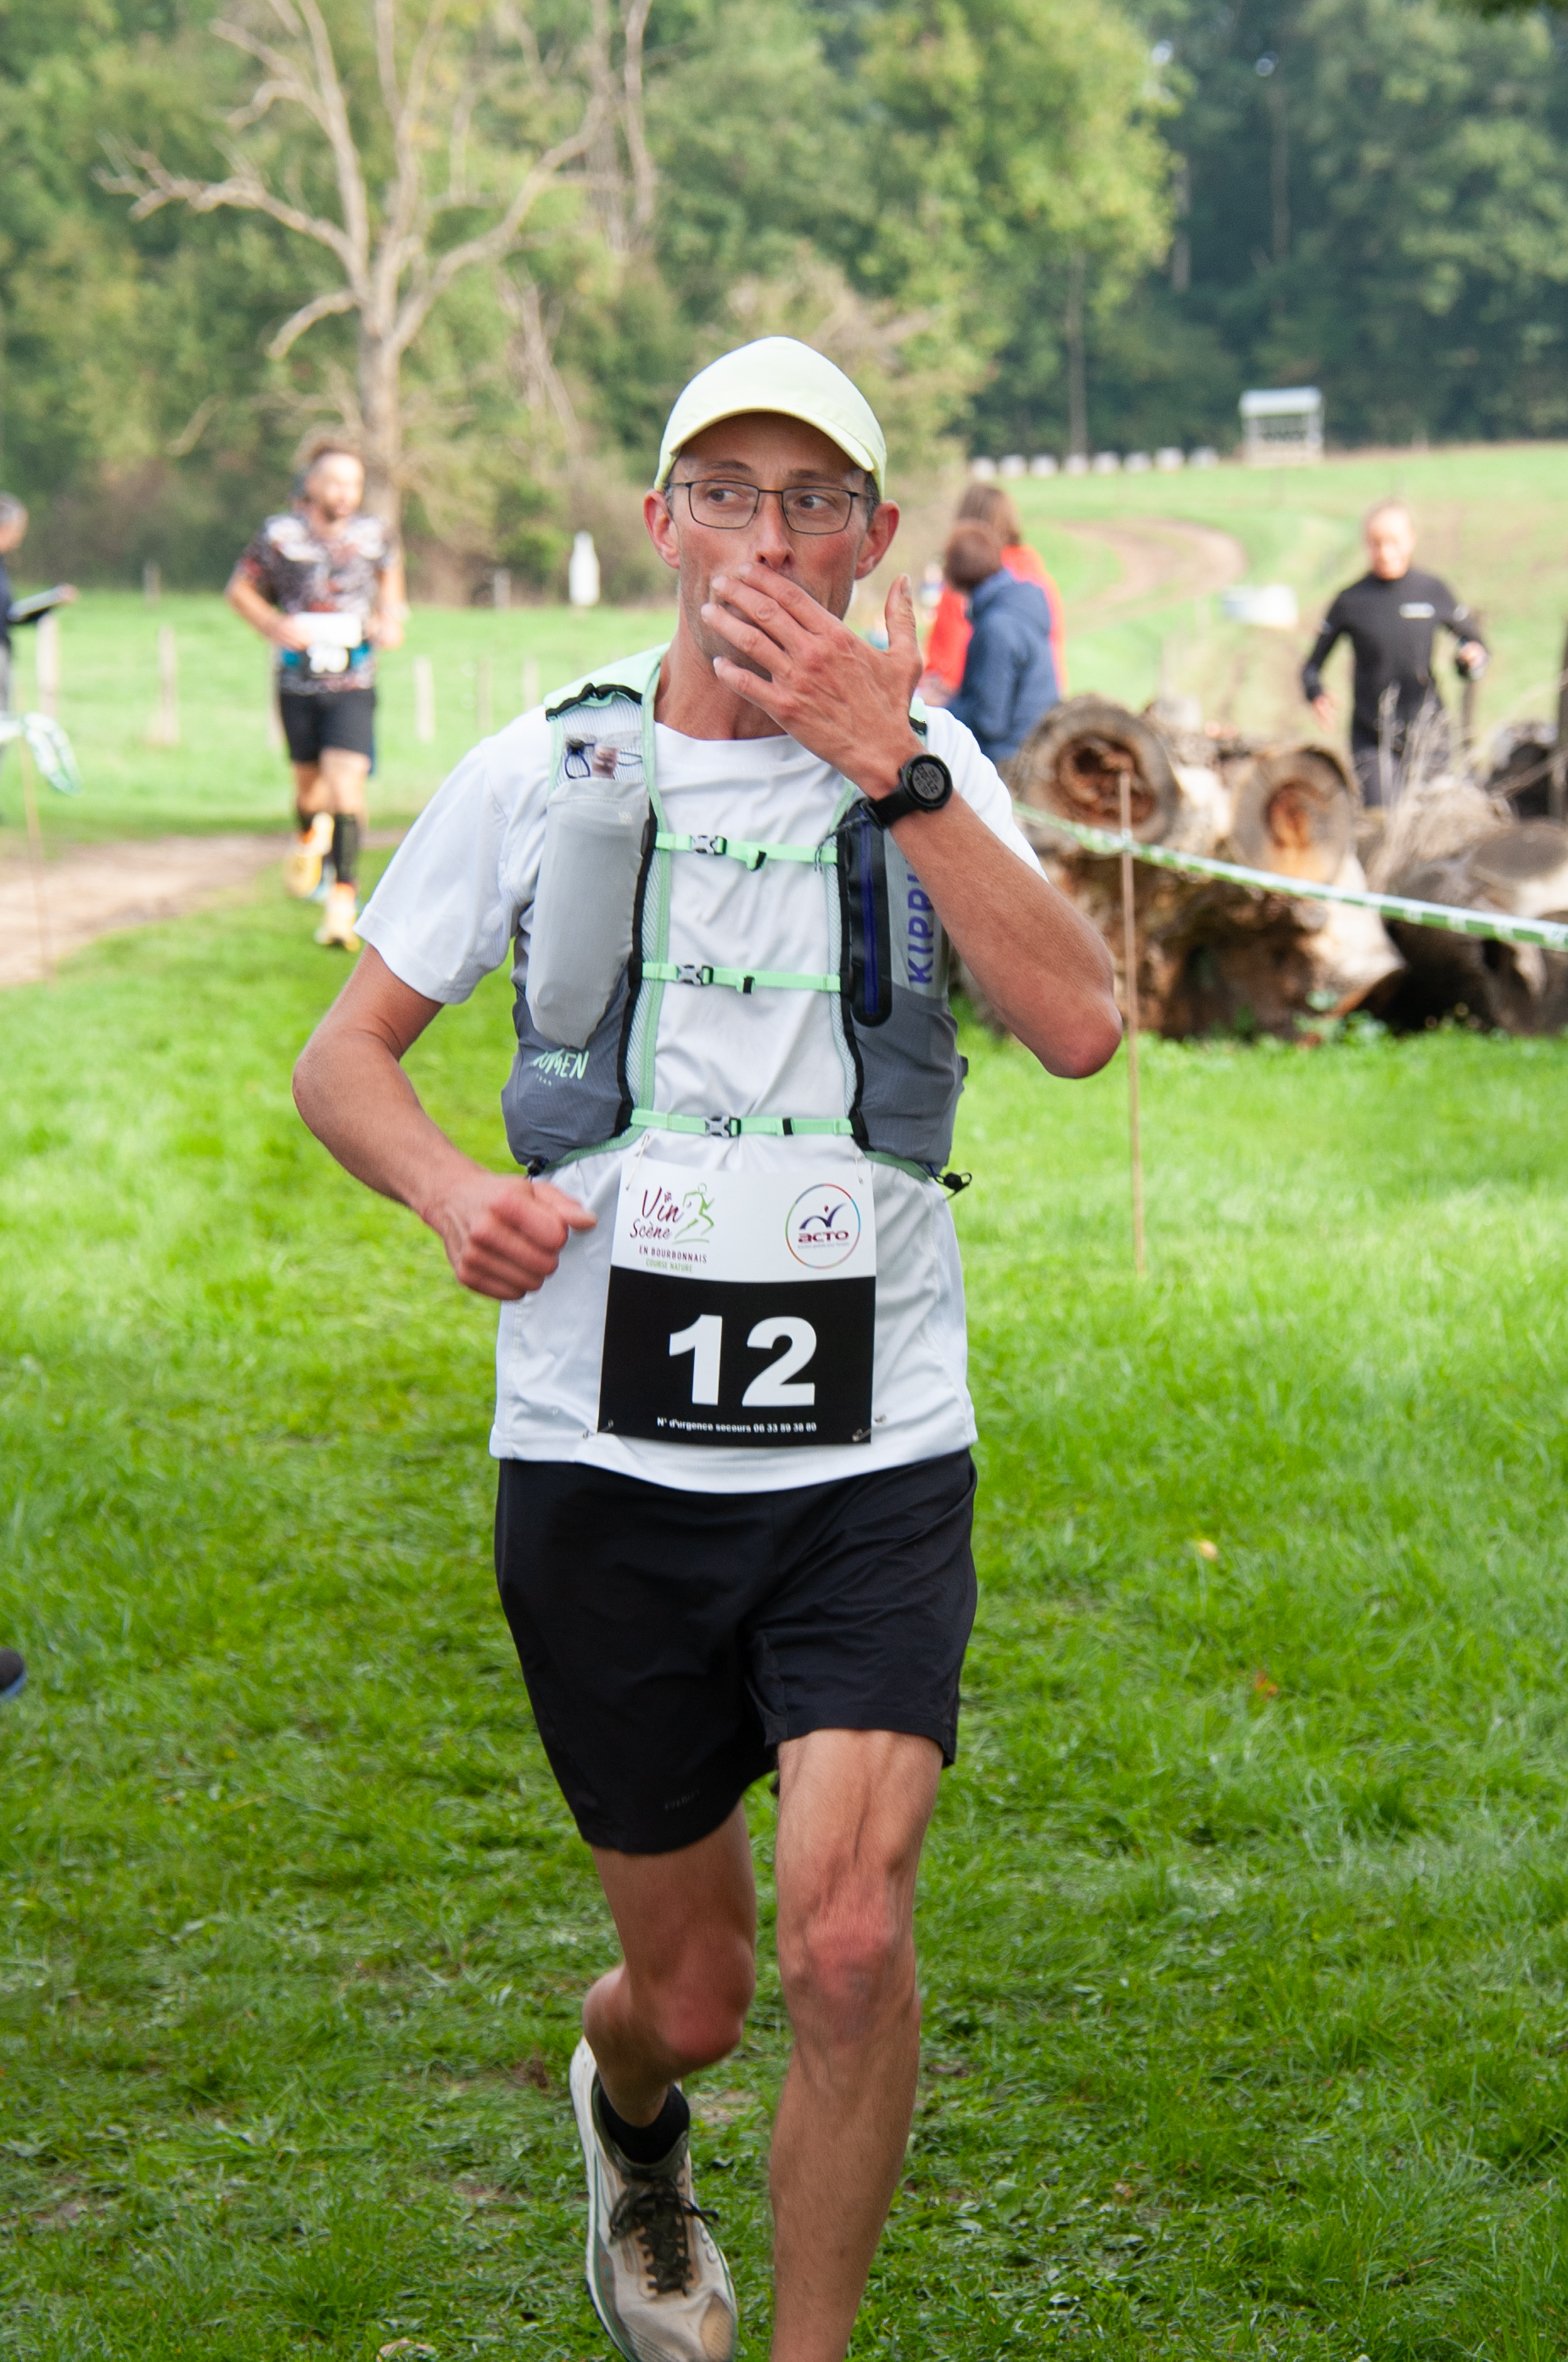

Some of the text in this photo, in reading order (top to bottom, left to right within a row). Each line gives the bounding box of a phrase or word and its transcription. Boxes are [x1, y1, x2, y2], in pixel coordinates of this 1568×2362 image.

[907, 872, 934, 985] KIPR
[642, 1185, 684, 1223] Vin
[630, 1218, 671, 1239] Scène
[639, 1244, 707, 1263] EN BOURBONNAIS
[669, 1261, 692, 1272] NATURE
[667, 1314, 818, 1408] 12
[669, 1419, 714, 1431] d'urgence
[715, 1423, 752, 1433] secours
